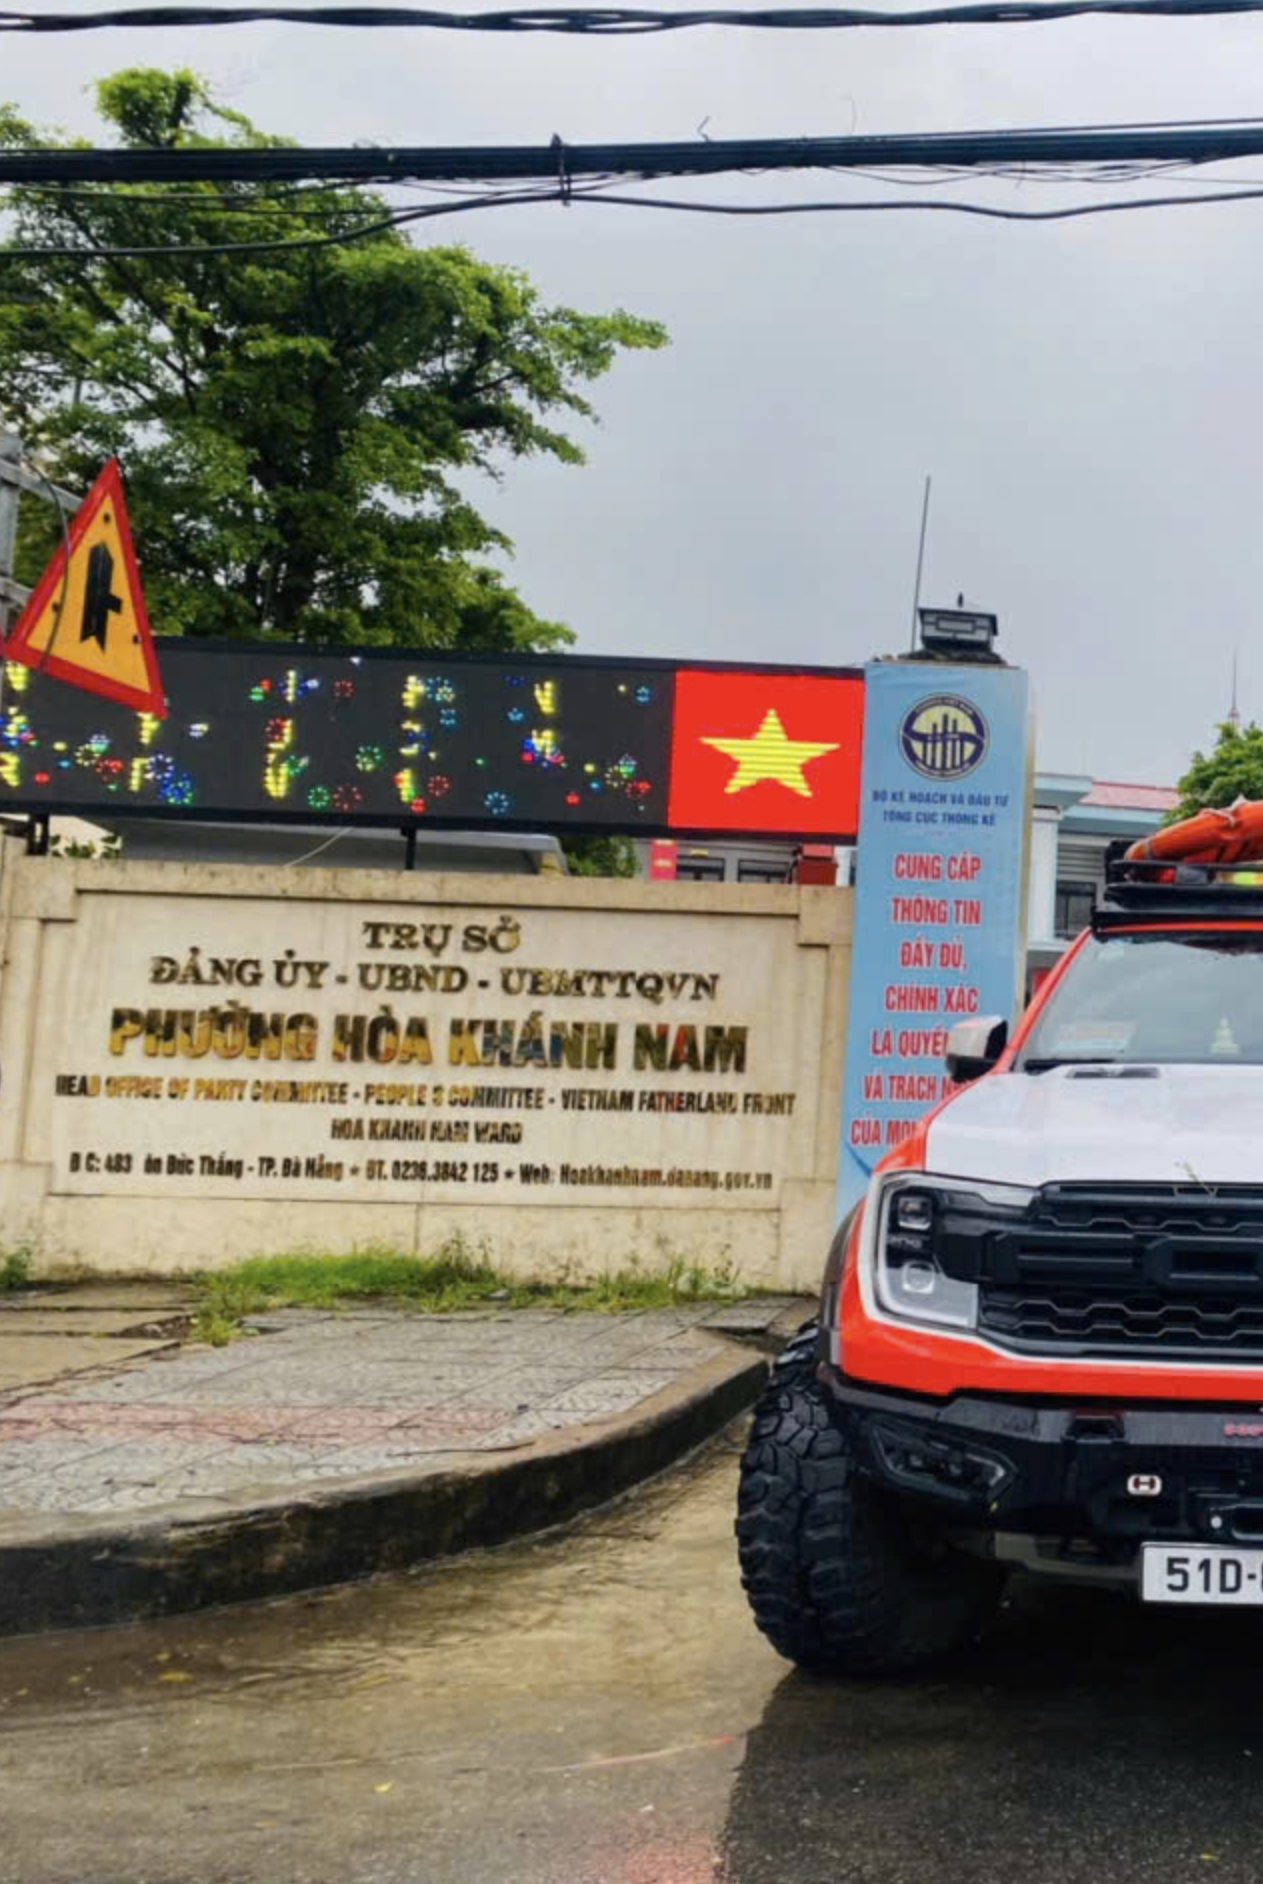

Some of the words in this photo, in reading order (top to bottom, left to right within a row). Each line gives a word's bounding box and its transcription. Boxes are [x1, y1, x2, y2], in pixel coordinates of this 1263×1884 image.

[895, 853, 941, 880] CUNG
[947, 850, 981, 881] CẤP
[892, 893, 948, 924] THÔNG
[954, 900, 981, 925] TIN
[362, 921, 452, 957] TRỤ
[461, 915, 522, 953] SỞ
[150, 946, 263, 987] ĐẢNG
[273, 949, 330, 989] ỦY
[358, 963, 468, 993] UBND
[501, 967, 720, 1004] UBMTTQVN
[885, 980, 939, 1012] CHÍNH
[944, 982, 979, 1013] XÁC
[109, 999, 319, 1062] PHƯỜNG
[331, 1004, 433, 1064] HÒA
[448, 1010, 619, 1070] KHÁNH
[633, 1022, 749, 1073] NAM
[871, 1023, 892, 1057] LÀ
[56, 1075, 101, 1097] HEAD
[105, 1076, 163, 1099] OFFICE
[167, 1077, 190, 1100] OF
[193, 1078, 248, 1101] PARTY
[251, 1080, 349, 1104] COMMITTEE
[364, 1083, 428, 1107] PEOPLE
[448, 1085, 545, 1109] COMMITTEE
[561, 1088, 635, 1111] VIETNAM
[638, 1090, 738, 1115] FATHERLAND
[742, 1092, 797, 1117] FRONT
[864, 1069, 884, 1099] VÀ
[330, 1117, 364, 1140] HOA
[368, 1118, 426, 1142] KHANH
[430, 1119, 470, 1143] NAM
[475, 1121, 523, 1144] WARD
[851, 1112, 881, 1145] CỦA
[104, 1152, 132, 1174] 483
[199, 1150, 243, 1179] Thắng
[258, 1157, 278, 1177] TP.
[391, 1159, 467, 1182] 0236.3842
[473, 1161, 499, 1183] 125
